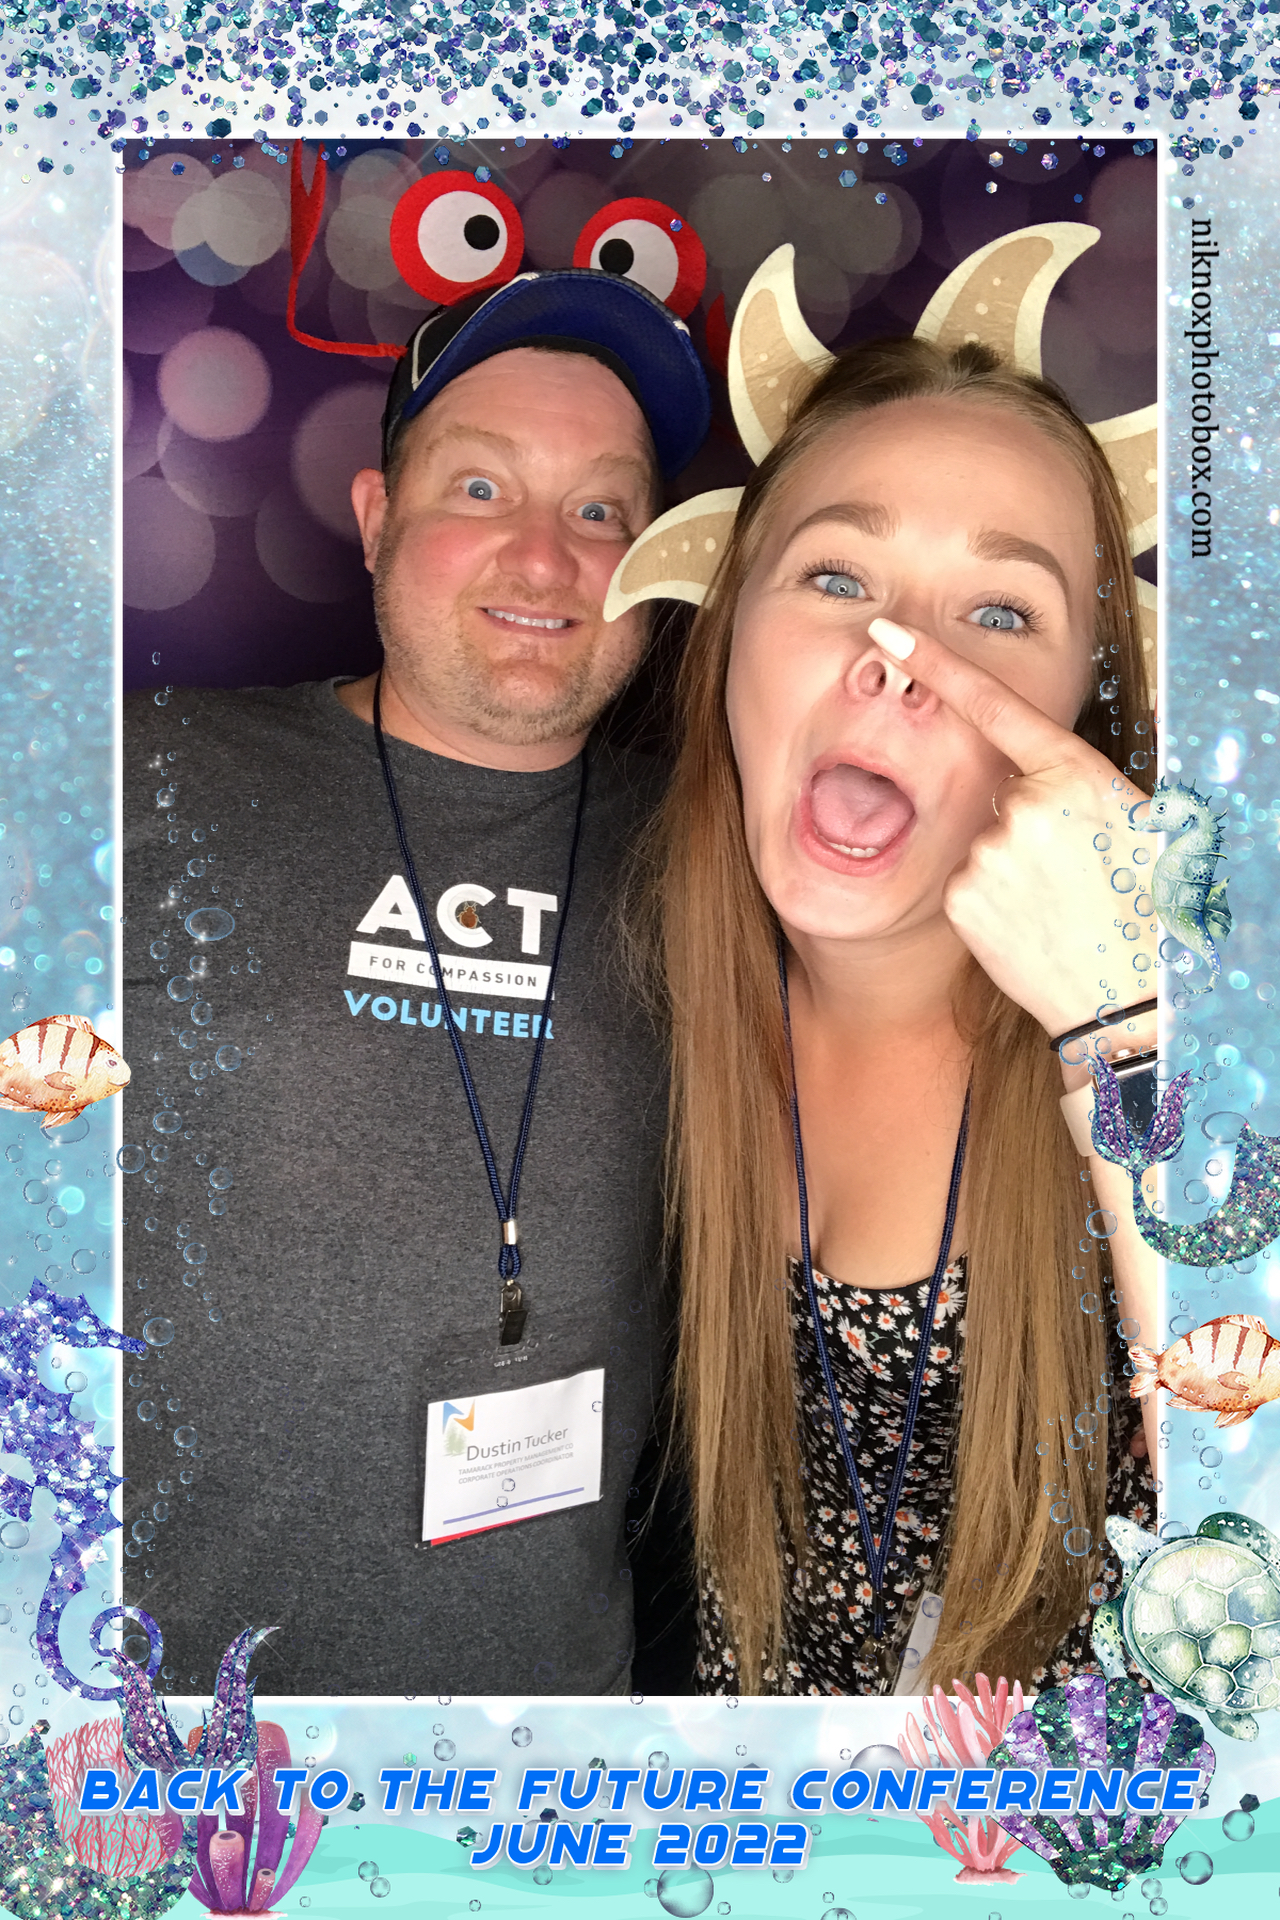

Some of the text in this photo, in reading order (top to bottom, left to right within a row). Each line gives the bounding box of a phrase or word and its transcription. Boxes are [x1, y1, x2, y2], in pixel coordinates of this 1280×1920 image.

[355, 874, 558, 955] ACT
[369, 955, 537, 988] FOR COMPASSION
[343, 989, 555, 1040] VOLUNTEER
[458, 1463, 494, 1475] TAMARACK
[494, 1456, 524, 1468] PROPERTY
[525, 1444, 565, 1461] MANAGEMENT
[466, 1428, 569, 1461] Dustin Tucker
[458, 1451, 574, 1485] CORPORATE OPERATIONS COORDINATOR
